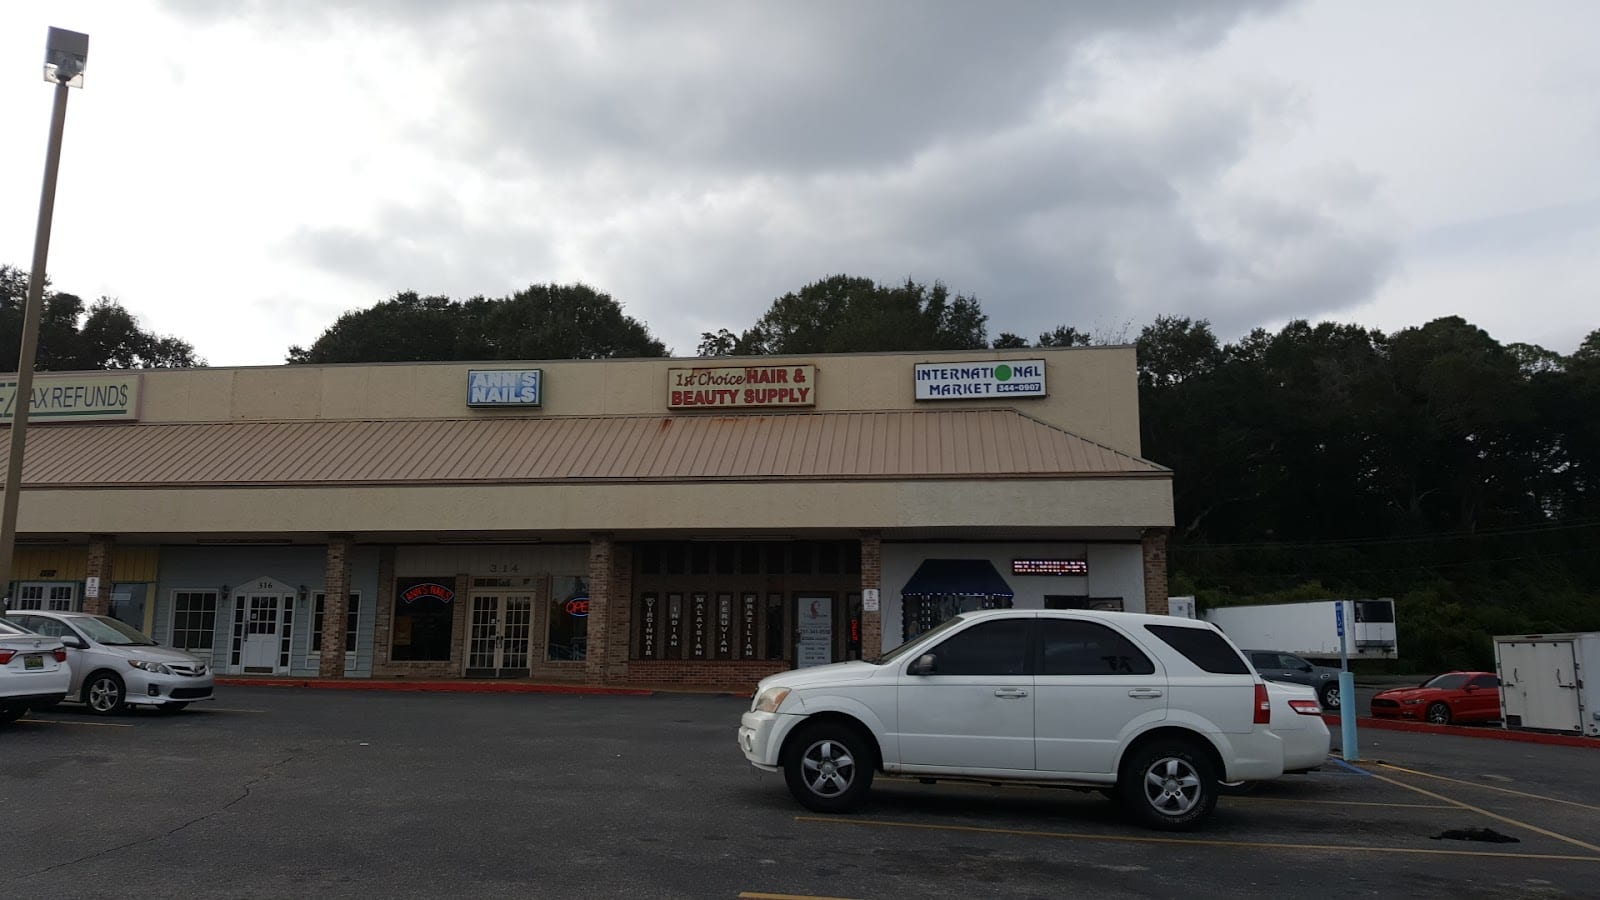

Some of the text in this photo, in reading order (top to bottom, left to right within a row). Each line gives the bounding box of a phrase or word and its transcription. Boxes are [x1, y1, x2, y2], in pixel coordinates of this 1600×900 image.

[676, 368, 806, 387] 1st Choice HAIR &
[929, 383, 992, 396] MARKET
[471, 386, 536, 403] NAILS
[671, 387, 810, 406] BEAUTY SUPPLY
[671, 606, 679, 647] INDIAN
[695, 597, 704, 656] MALAYSIAN
[720, 600, 729, 653] PERUVIAN
[745, 597, 753, 656] BRAZILIAN
